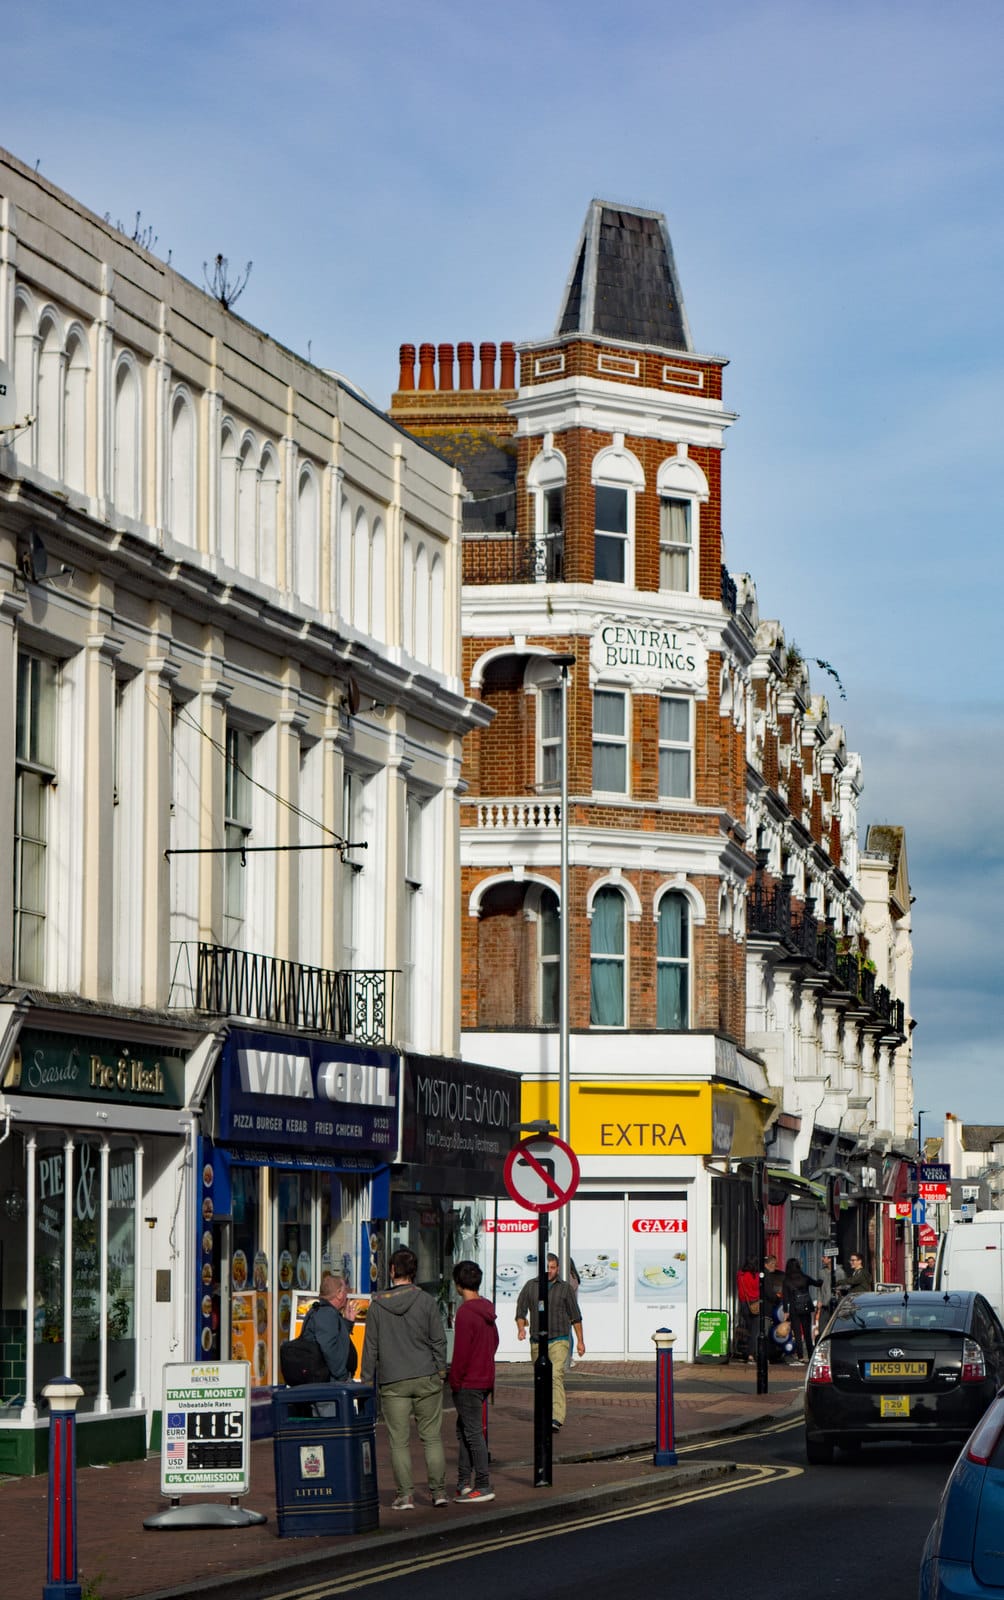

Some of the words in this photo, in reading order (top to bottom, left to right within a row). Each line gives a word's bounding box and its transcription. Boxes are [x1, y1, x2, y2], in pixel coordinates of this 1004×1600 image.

[602, 627, 682, 650] CENTRAL
[605, 646, 696, 671] BUILDINGS
[28, 1048, 80, 1088] Seaside
[90, 1055, 113, 1088] Pie
[117, 1057, 129, 1089] &
[130, 1059, 165, 1093] Mash
[238, 1049, 314, 1099] VINA
[317, 1062, 396, 1107] GRILL
[416, 1075, 472, 1122] MYSTIQUE
[474, 1086, 510, 1128] SALON
[233, 1114, 254, 1129] PIZZA
[256, 1116, 283, 1131] BURGER
[286, 1119, 308, 1133] KEBAB
[315, 1121, 334, 1135] FRIED
[335, 1124, 363, 1138] CHICKEN
[600, 1123, 687, 1147] EXTRA
[38, 1154, 64, 1200] PIE
[76, 1143, 96, 1221] &
[110, 1163, 134, 1200] MASH
[925, 1183, 939, 1192] LET
[637, 1219, 686, 1233] GAZI
[191, 1366, 220, 1376] CASH
[872, 1363, 902, 1374] HK59
[904, 1363, 926, 1374] VLM
[168, 1390, 203, 1399] TRAVEL
[204, 1388, 243, 1398] MONEY?
[167, 1428, 186, 1436] EURO
[195, 1412, 242, 1438] 1.115
[168, 1458, 183, 1466] USD
[168, 1474, 182, 1482] 0%
[183, 1473, 240, 1482] COMMISSION
[296, 1487, 333, 1497] LITTER
